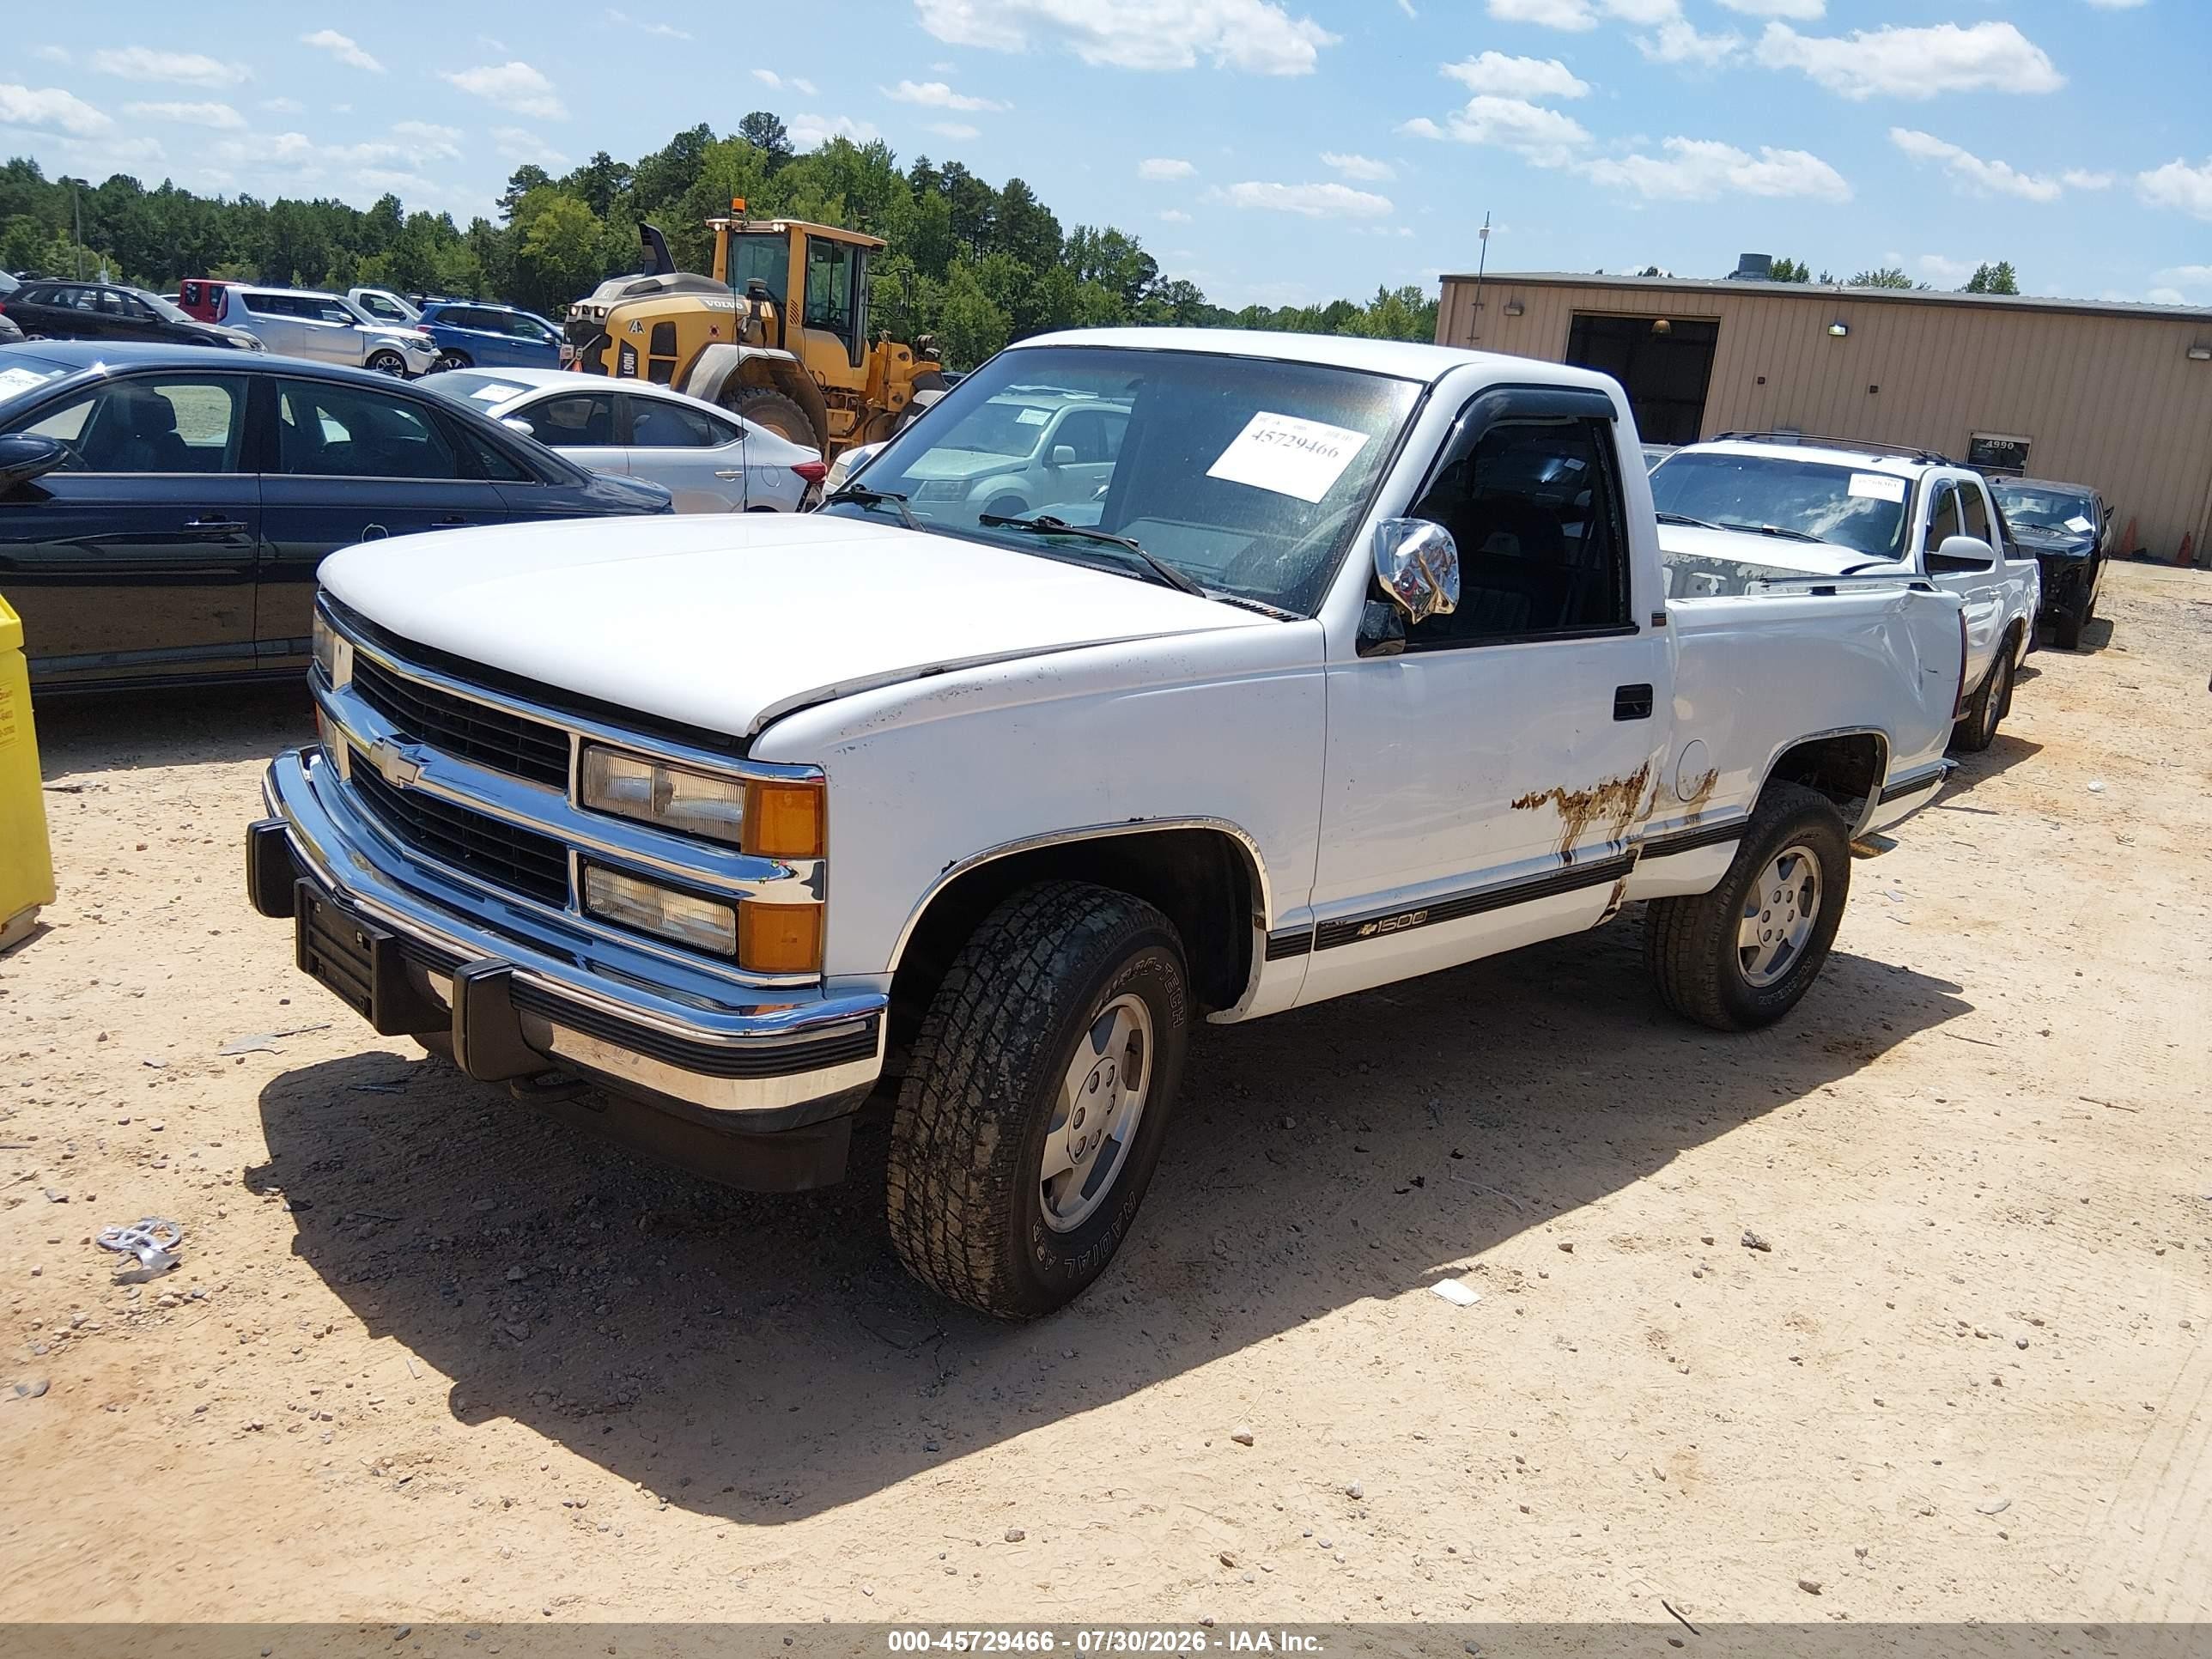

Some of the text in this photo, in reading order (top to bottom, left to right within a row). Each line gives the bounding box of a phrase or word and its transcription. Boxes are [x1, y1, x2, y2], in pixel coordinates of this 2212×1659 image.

[704, 300, 744, 310] VOLVO
[623, 352, 635, 375] L90H
[1251, 428, 1340, 458] 45729466
[1985, 441, 2014, 450] 4990
[1376, 910, 1428, 933] 1500
[1064, 1191, 1137, 1279] RADIAL
